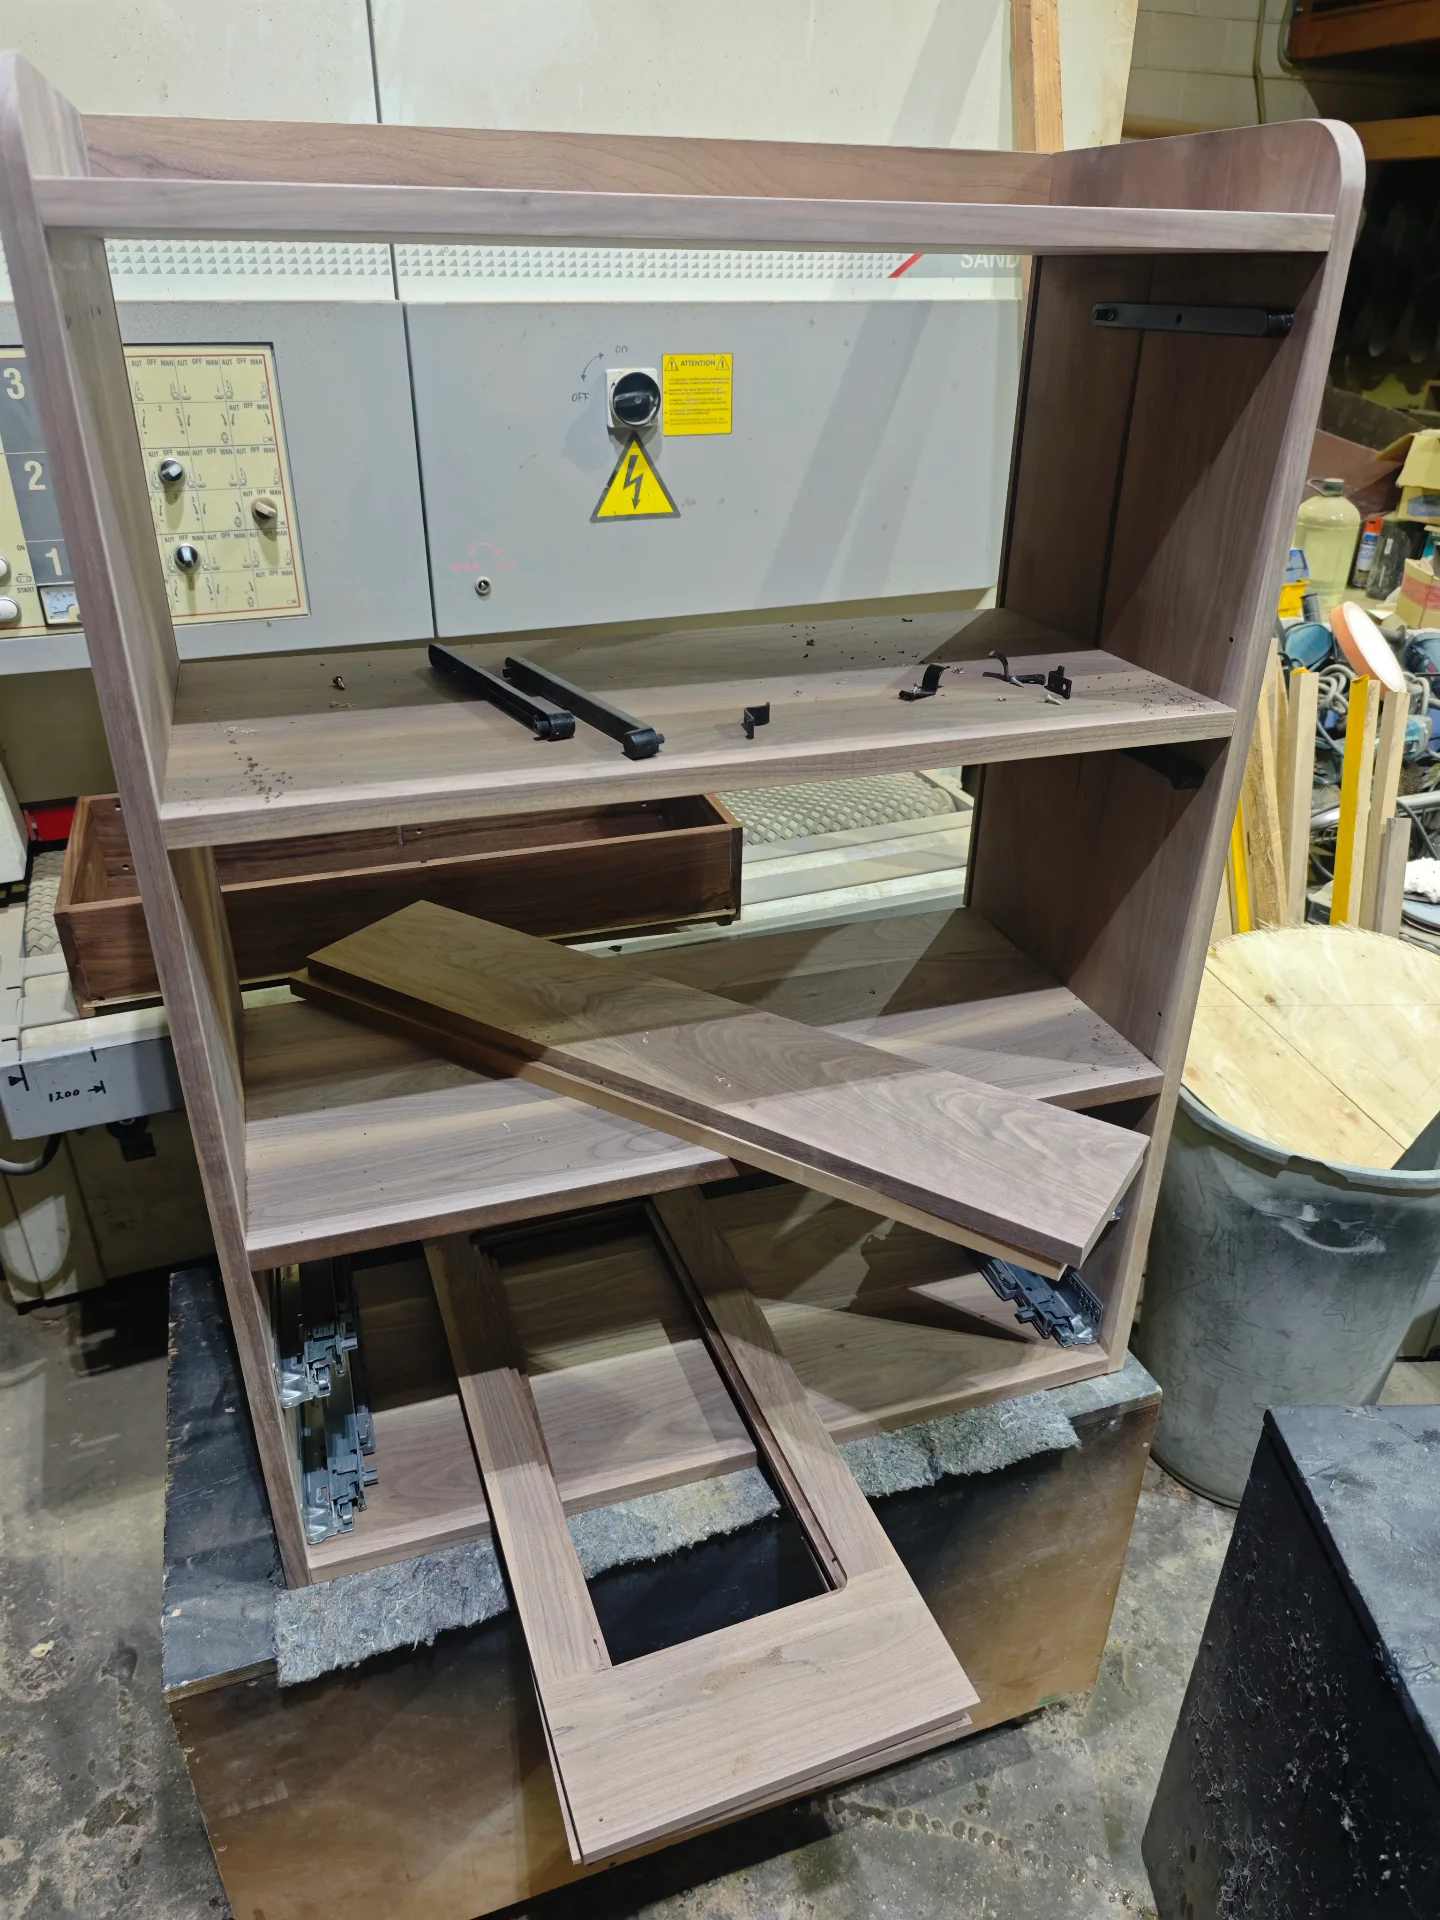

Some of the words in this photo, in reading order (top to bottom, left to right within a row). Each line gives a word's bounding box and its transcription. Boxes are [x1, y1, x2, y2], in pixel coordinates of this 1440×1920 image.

[146, 358, 157, 366] OFF
[160, 359, 174, 367] MAN
[177, 359, 188, 367] AUT
[3, 367, 25, 400] 3
[571, 392, 590, 403] OFF
[24, 460, 47, 491] 2
[45, 547, 63, 576] 1
[48, 1089, 80, 1102] 1200
